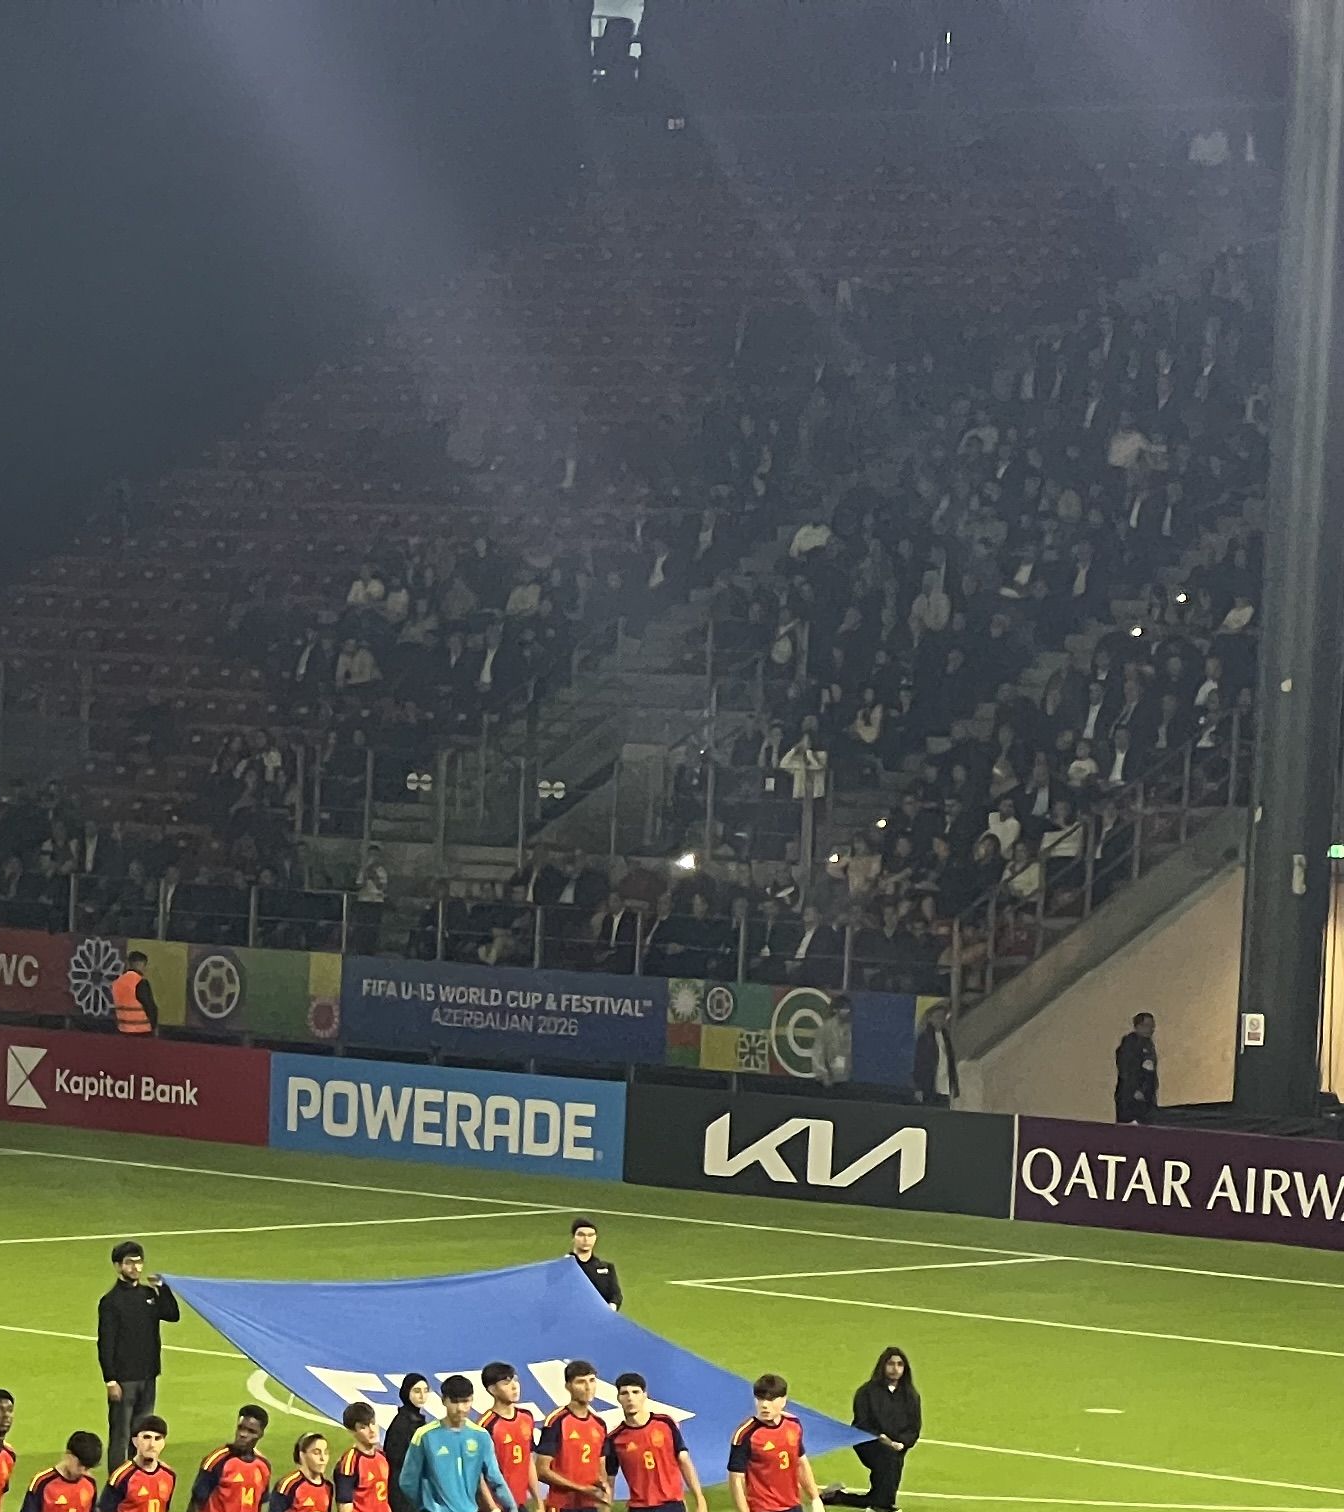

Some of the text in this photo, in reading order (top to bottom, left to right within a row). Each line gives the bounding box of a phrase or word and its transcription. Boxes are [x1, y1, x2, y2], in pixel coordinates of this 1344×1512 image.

[362, 978, 398, 999] FIFA
[401, 981, 435, 1001] U-15
[438, 984, 501, 1007] WORLD
[507, 990, 543, 1010] CUP
[545, 993, 557, 1011] &
[431, 1007, 579, 1037] AZERBAIJAN 2026
[55, 1068, 199, 1106] Kapital Bank
[287, 1076, 596, 1161] POWERADE
[1021, 1147, 1344, 1222] QATAR AIRW
[457, 1455, 463, 1477] 1
[512, 1444, 523, 1465] 9
[581, 1444, 591, 1464] 2
[779, 1450, 790, 1470] 3
[241, 1486, 254, 1507] 14
